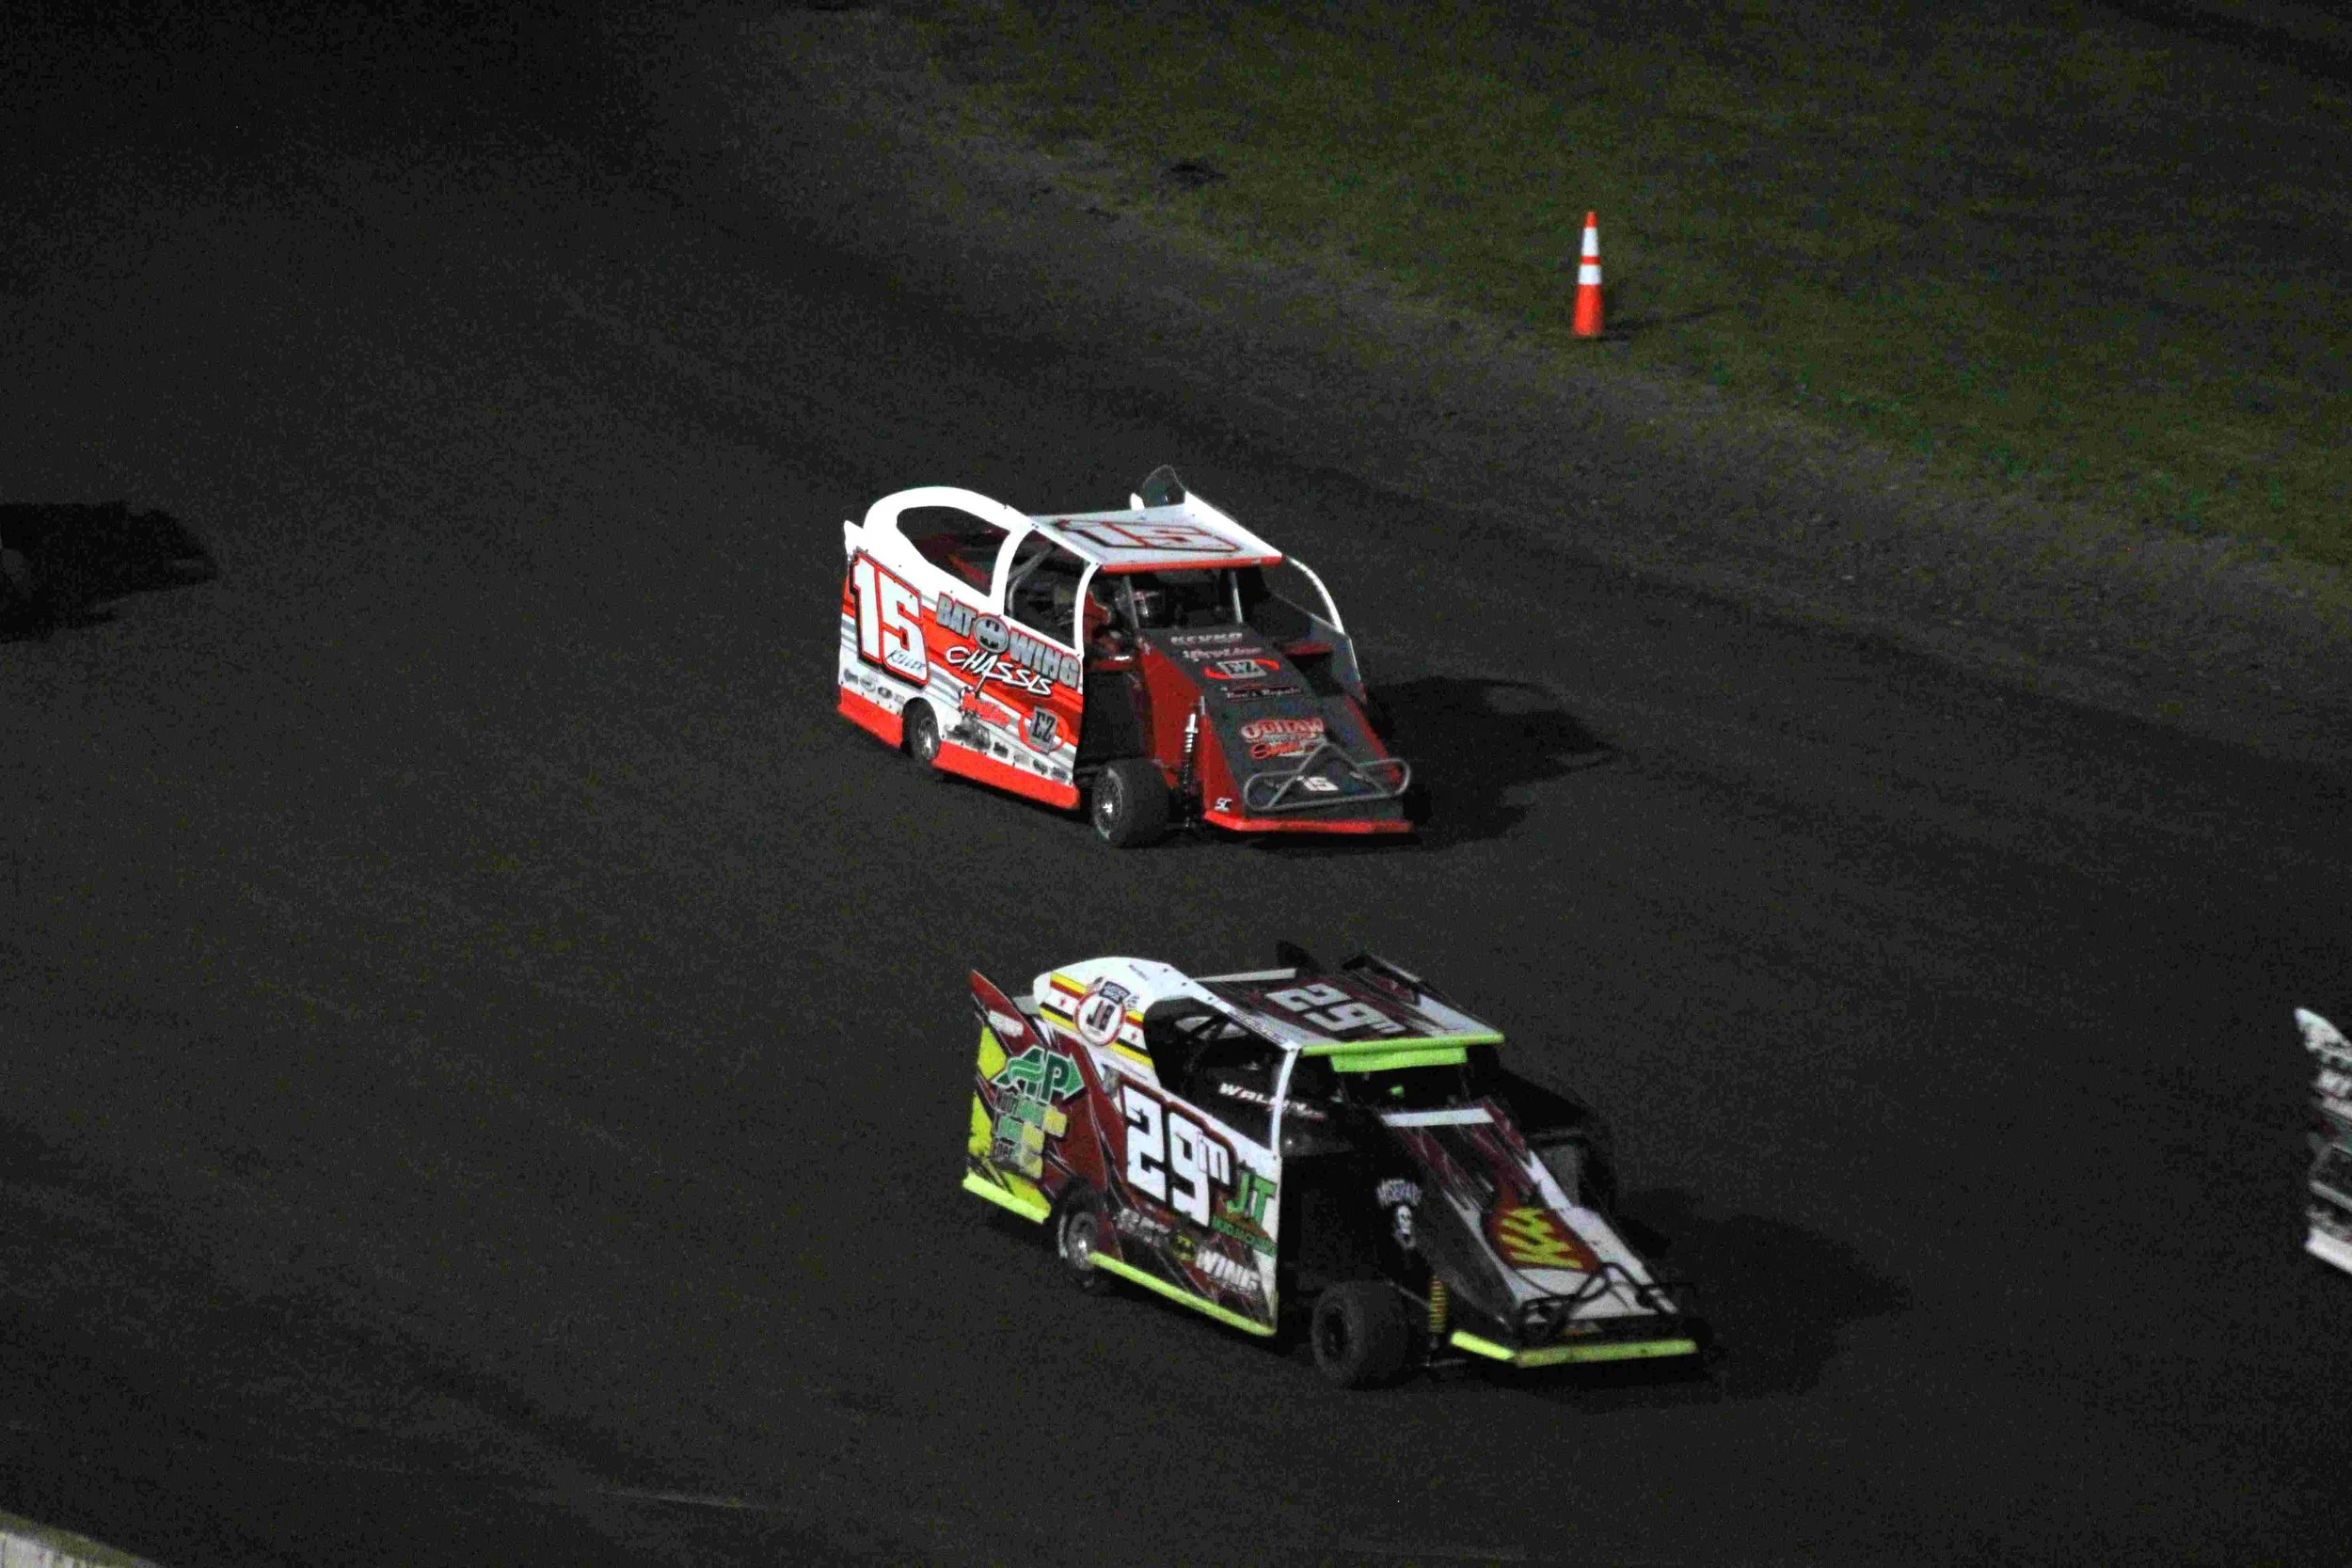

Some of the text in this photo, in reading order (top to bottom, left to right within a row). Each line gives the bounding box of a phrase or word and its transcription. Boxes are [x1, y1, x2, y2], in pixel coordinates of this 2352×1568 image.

[1052, 518, 1242, 553] 15
[851, 553, 929, 684] 15
[936, 592, 1081, 689] BAT WING
[946, 645, 1054, 696] CHASSIS
[1031, 710, 1056, 743] EZ
[1226, 1173, 1277, 1224] JT
[1196, 1244, 1262, 1292] WING
